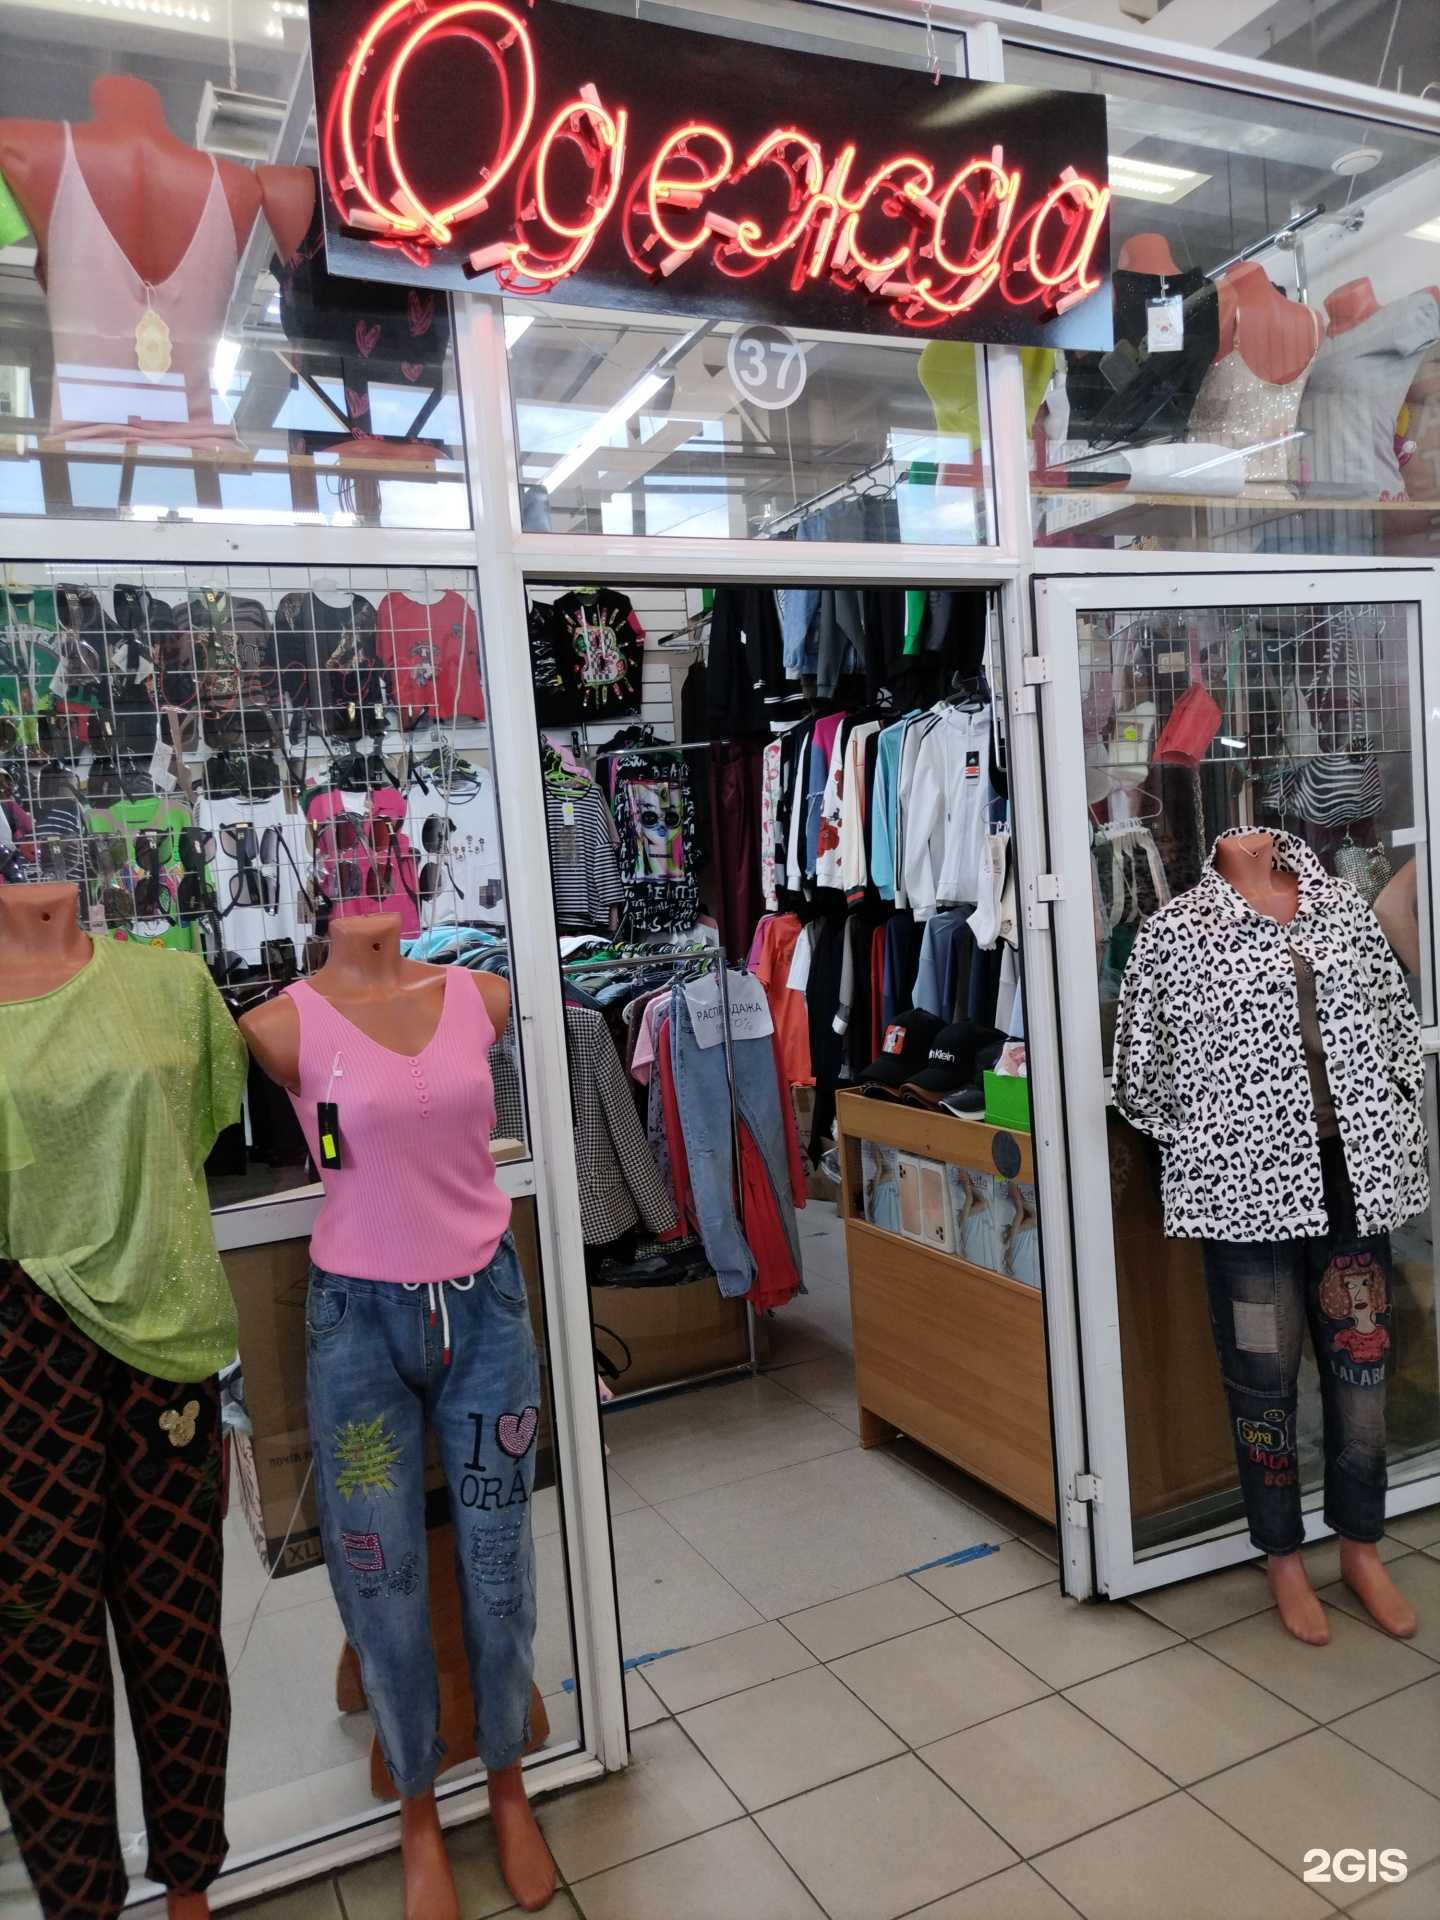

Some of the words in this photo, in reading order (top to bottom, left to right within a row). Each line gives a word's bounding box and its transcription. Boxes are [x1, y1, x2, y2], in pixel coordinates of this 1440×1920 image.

[338, 0, 1109, 314] Одежда
[739, 338, 801, 390] 37
[460, 1470, 529, 1512] ORA
[287, 1540, 320, 1565] XL
